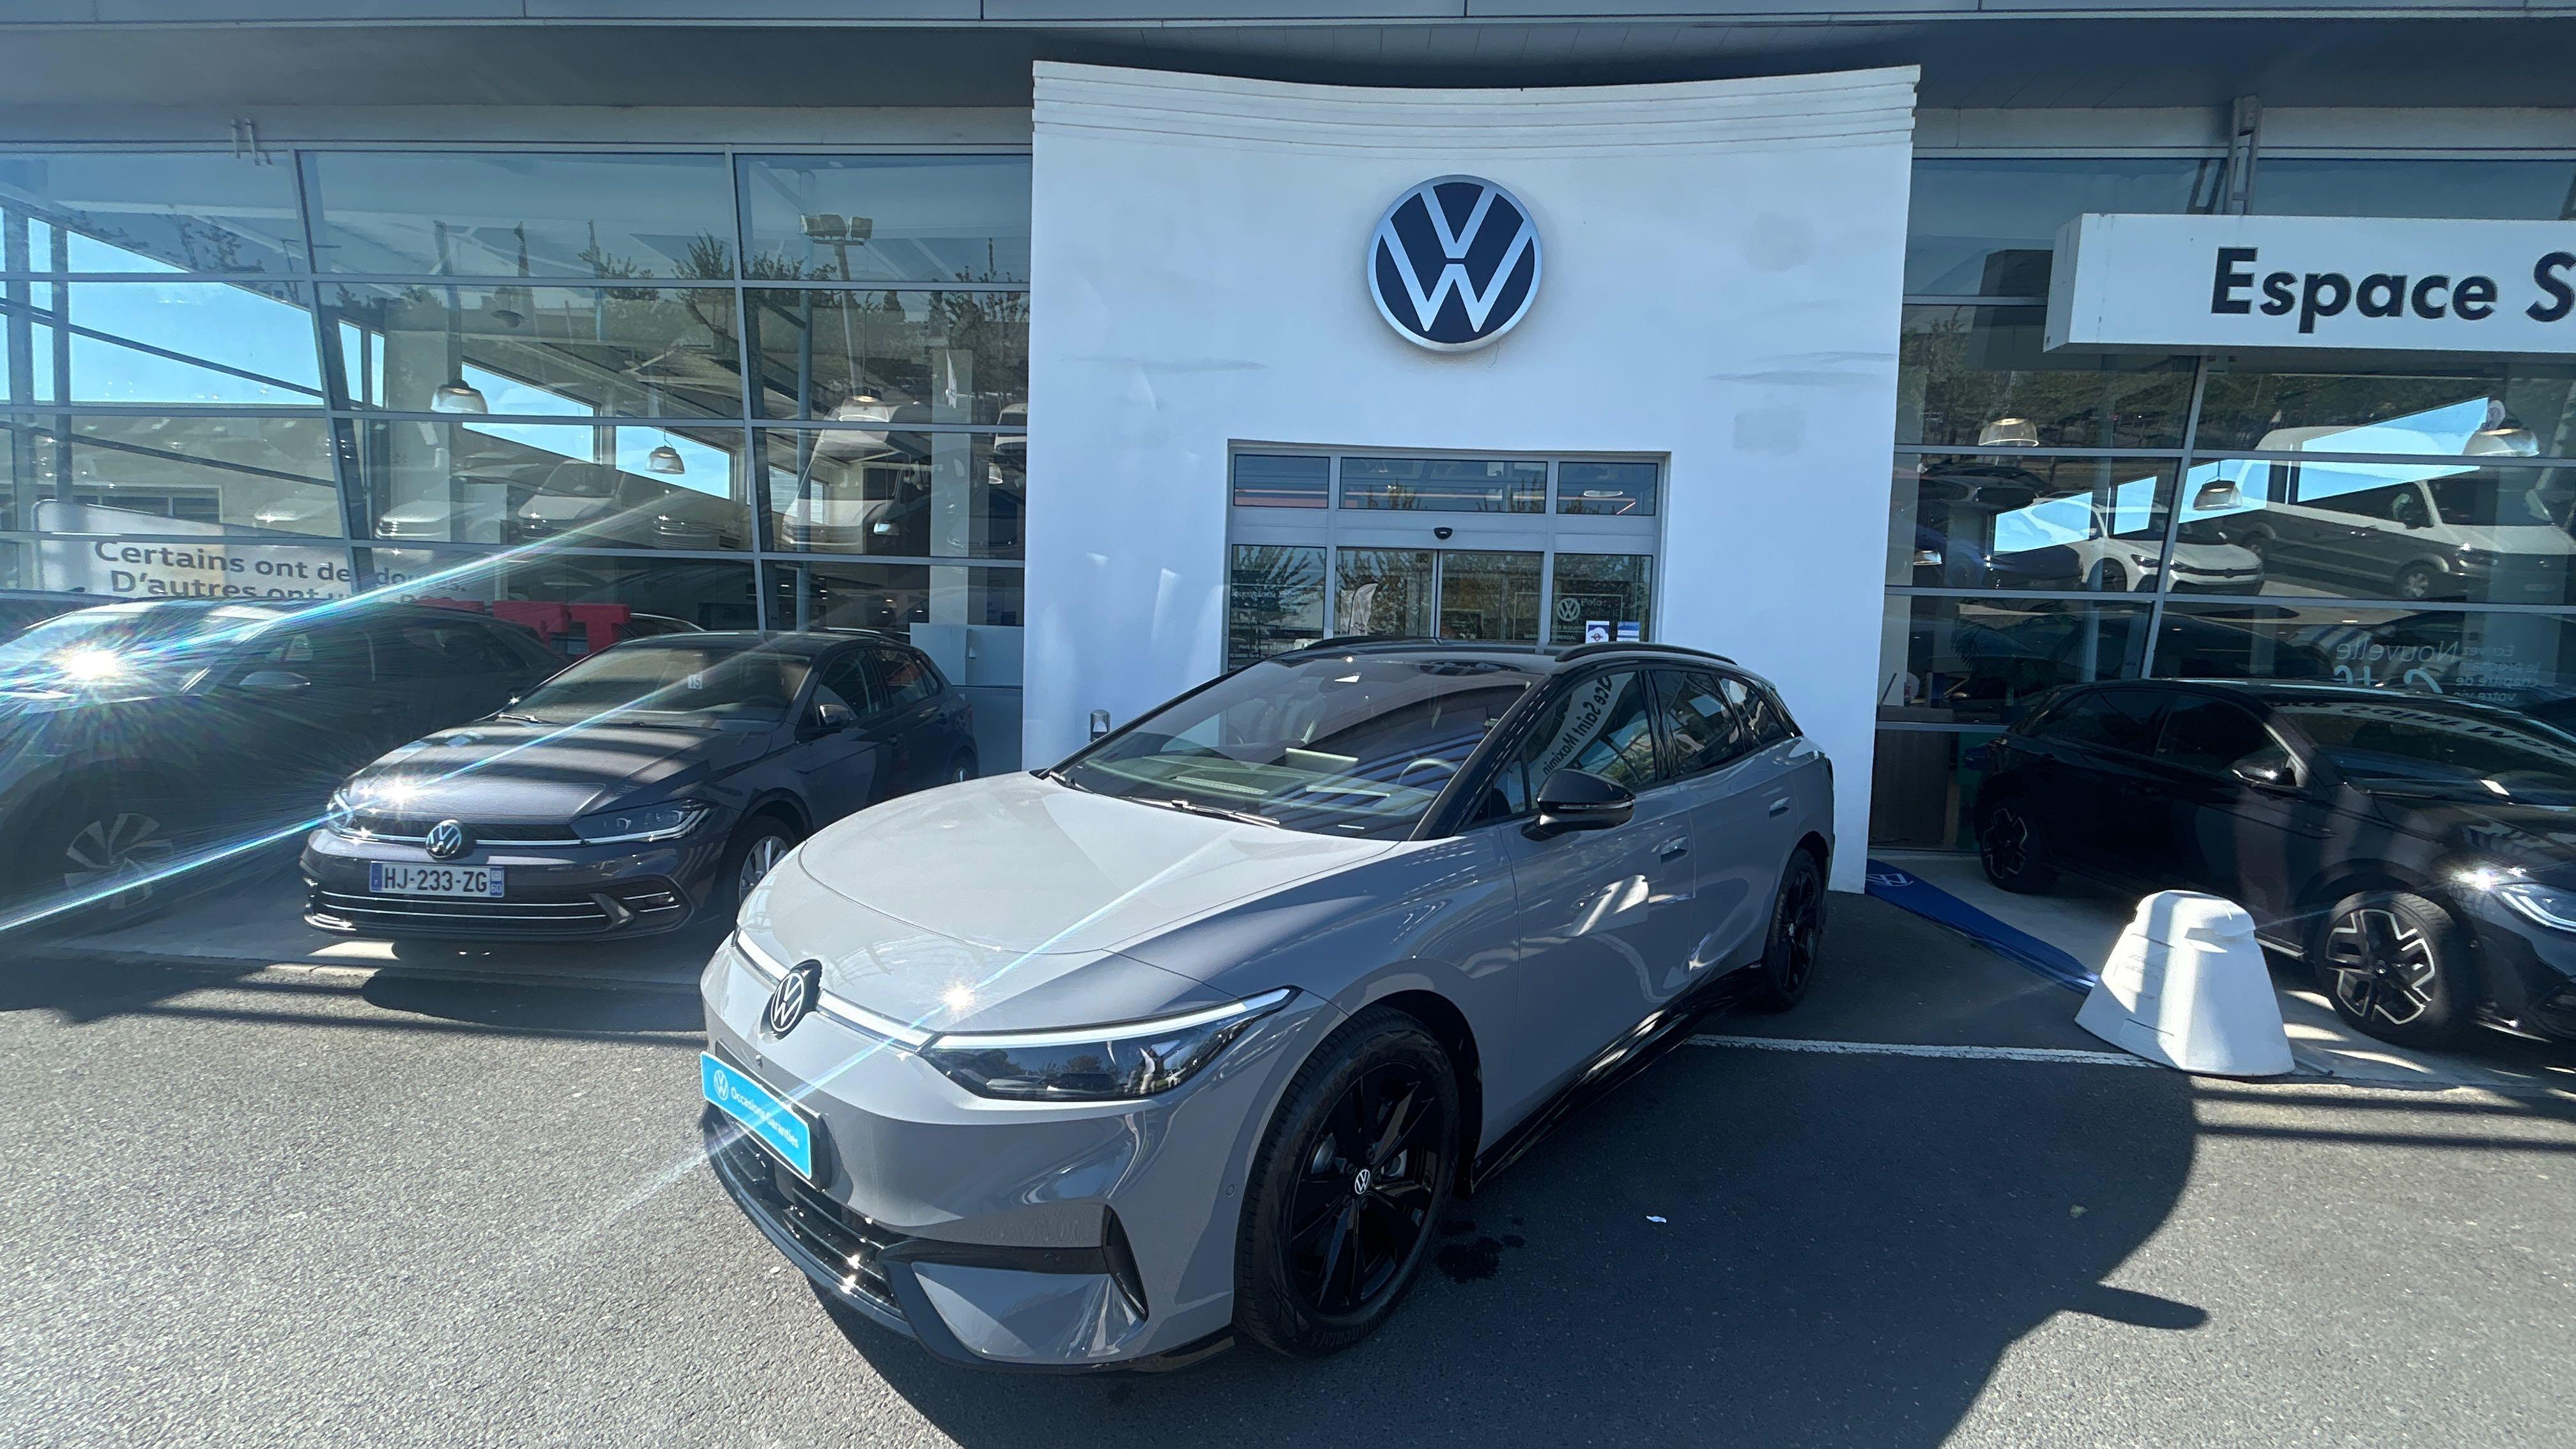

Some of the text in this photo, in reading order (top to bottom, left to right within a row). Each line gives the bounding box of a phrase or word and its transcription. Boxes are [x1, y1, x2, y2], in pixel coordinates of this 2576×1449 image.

[2211, 246, 2498, 334] Espace
[95, 542, 350, 582] Certains ont de
[111, 570, 256, 598] D'autres
[385, 867, 487, 893] HJ-233-ZG
